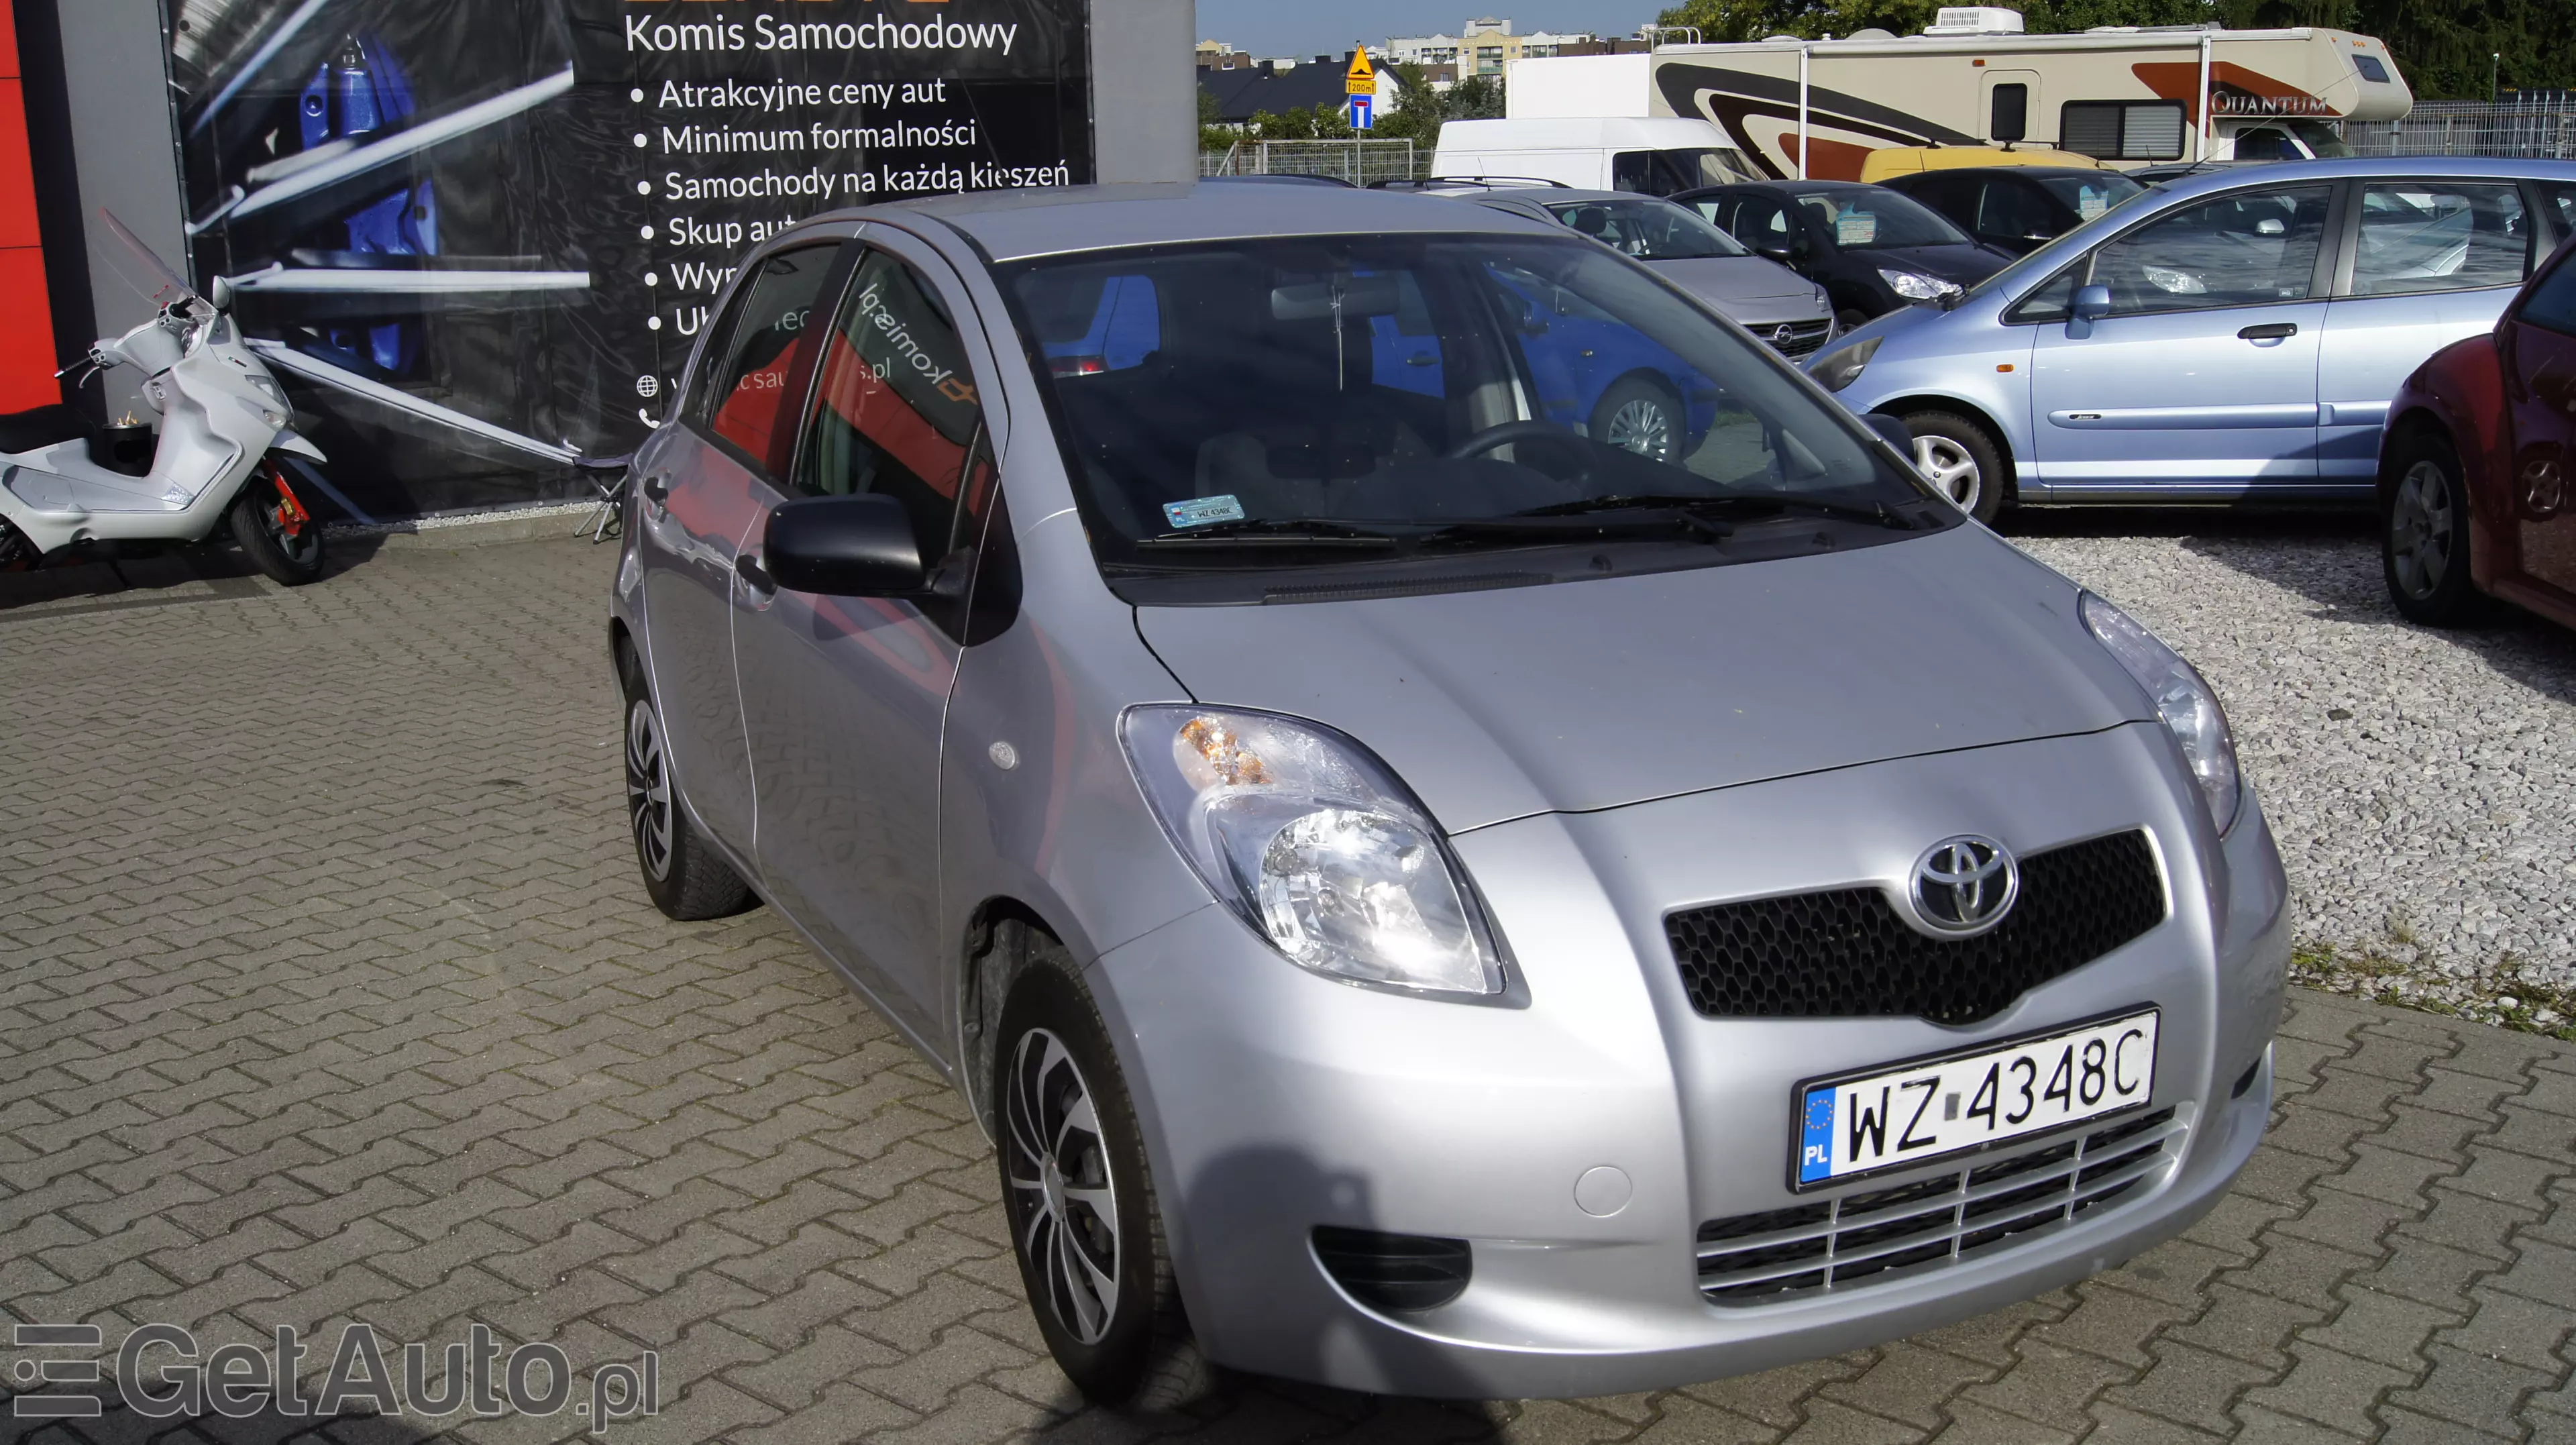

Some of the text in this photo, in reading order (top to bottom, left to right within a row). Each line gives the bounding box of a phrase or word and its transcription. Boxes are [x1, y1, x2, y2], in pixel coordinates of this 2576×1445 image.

[625, 13, 1018, 56] Komis Samochodowy
[658, 77, 947, 112] Atrakcyjne ceny aut
[662, 119, 976, 154] Minimum formalności
[665, 159, 1069, 200] Samochody na każdą kieszeń
[669, 216, 743, 249] Skup
[1196, 509, 1210, 517] WZ
[1849, 1028, 2143, 1163] WZ 4348C
[1805, 1144, 1827, 1166] PL
